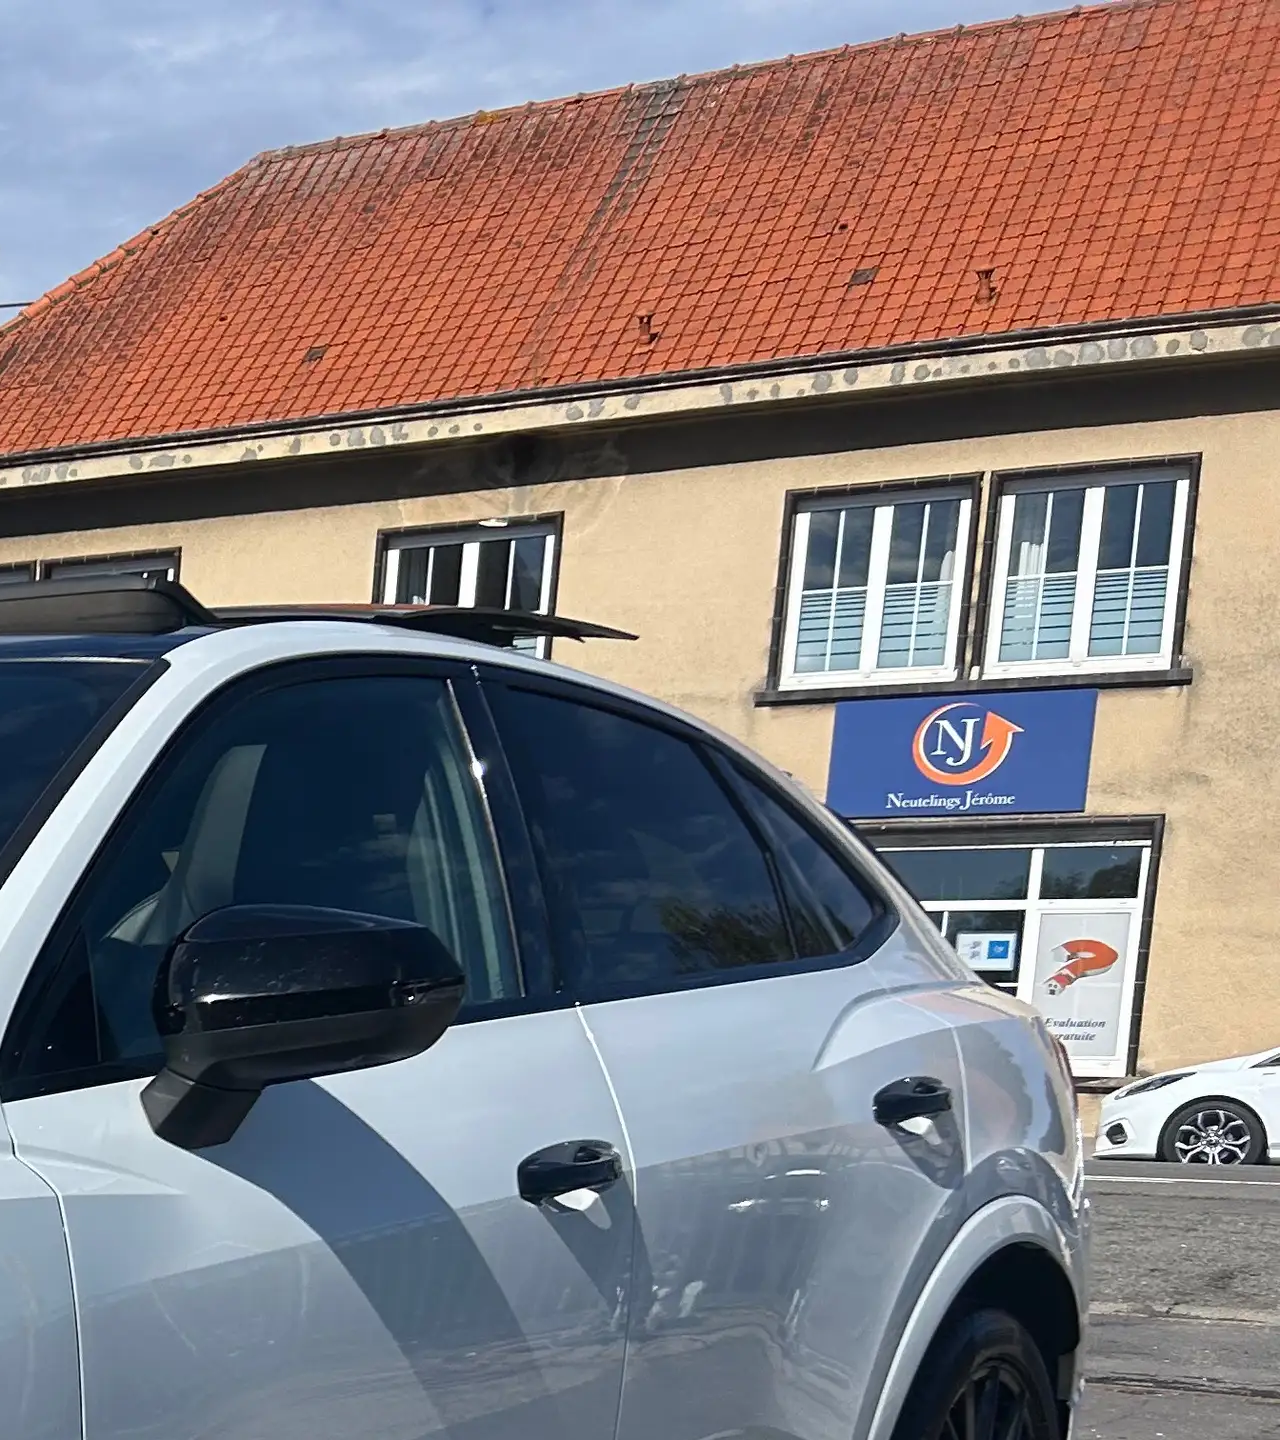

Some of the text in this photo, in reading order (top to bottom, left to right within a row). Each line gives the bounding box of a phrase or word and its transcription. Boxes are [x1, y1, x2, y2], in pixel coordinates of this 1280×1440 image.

[930, 718, 980, 766] NJ
[886, 790, 1015, 810] Neutelings Jérôme
[1044, 1017, 1106, 1028] Evaluation
[1053, 1032, 1096, 1041] ratuite
